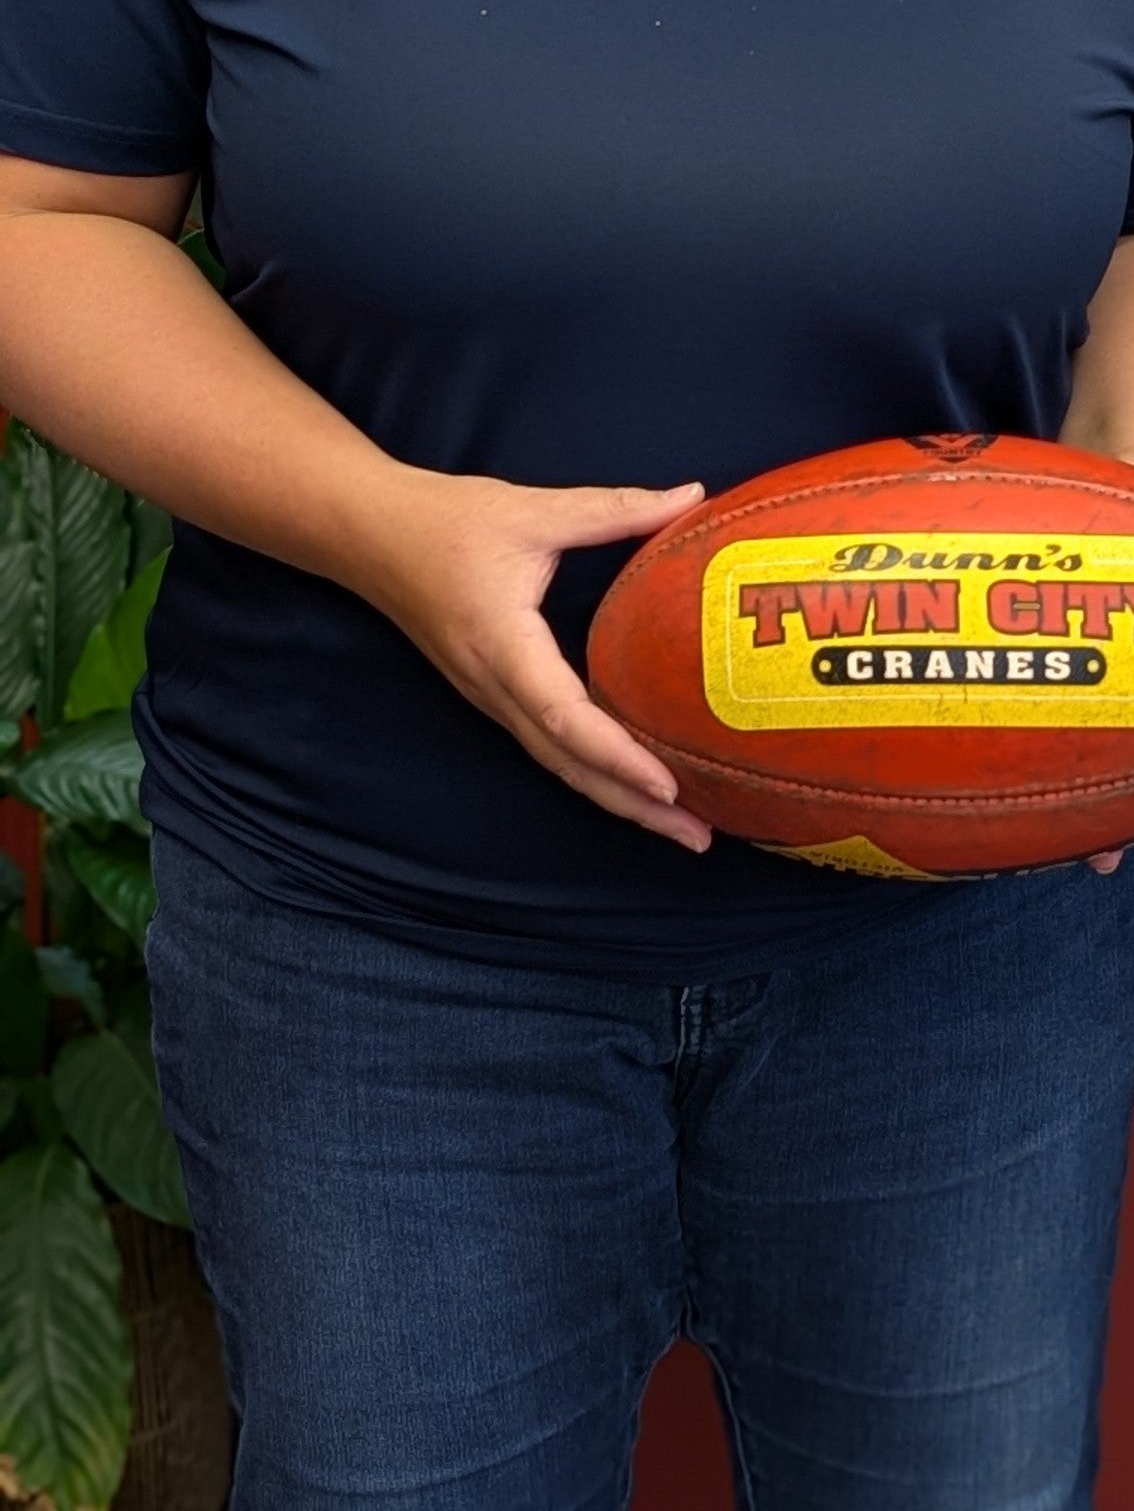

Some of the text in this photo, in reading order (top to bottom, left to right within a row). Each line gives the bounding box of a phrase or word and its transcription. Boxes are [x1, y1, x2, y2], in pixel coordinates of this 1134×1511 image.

[828, 542, 1083, 572] Dunn's
[738, 579, 961, 647] TWIN
[846, 649, 1072, 681] CRANES
